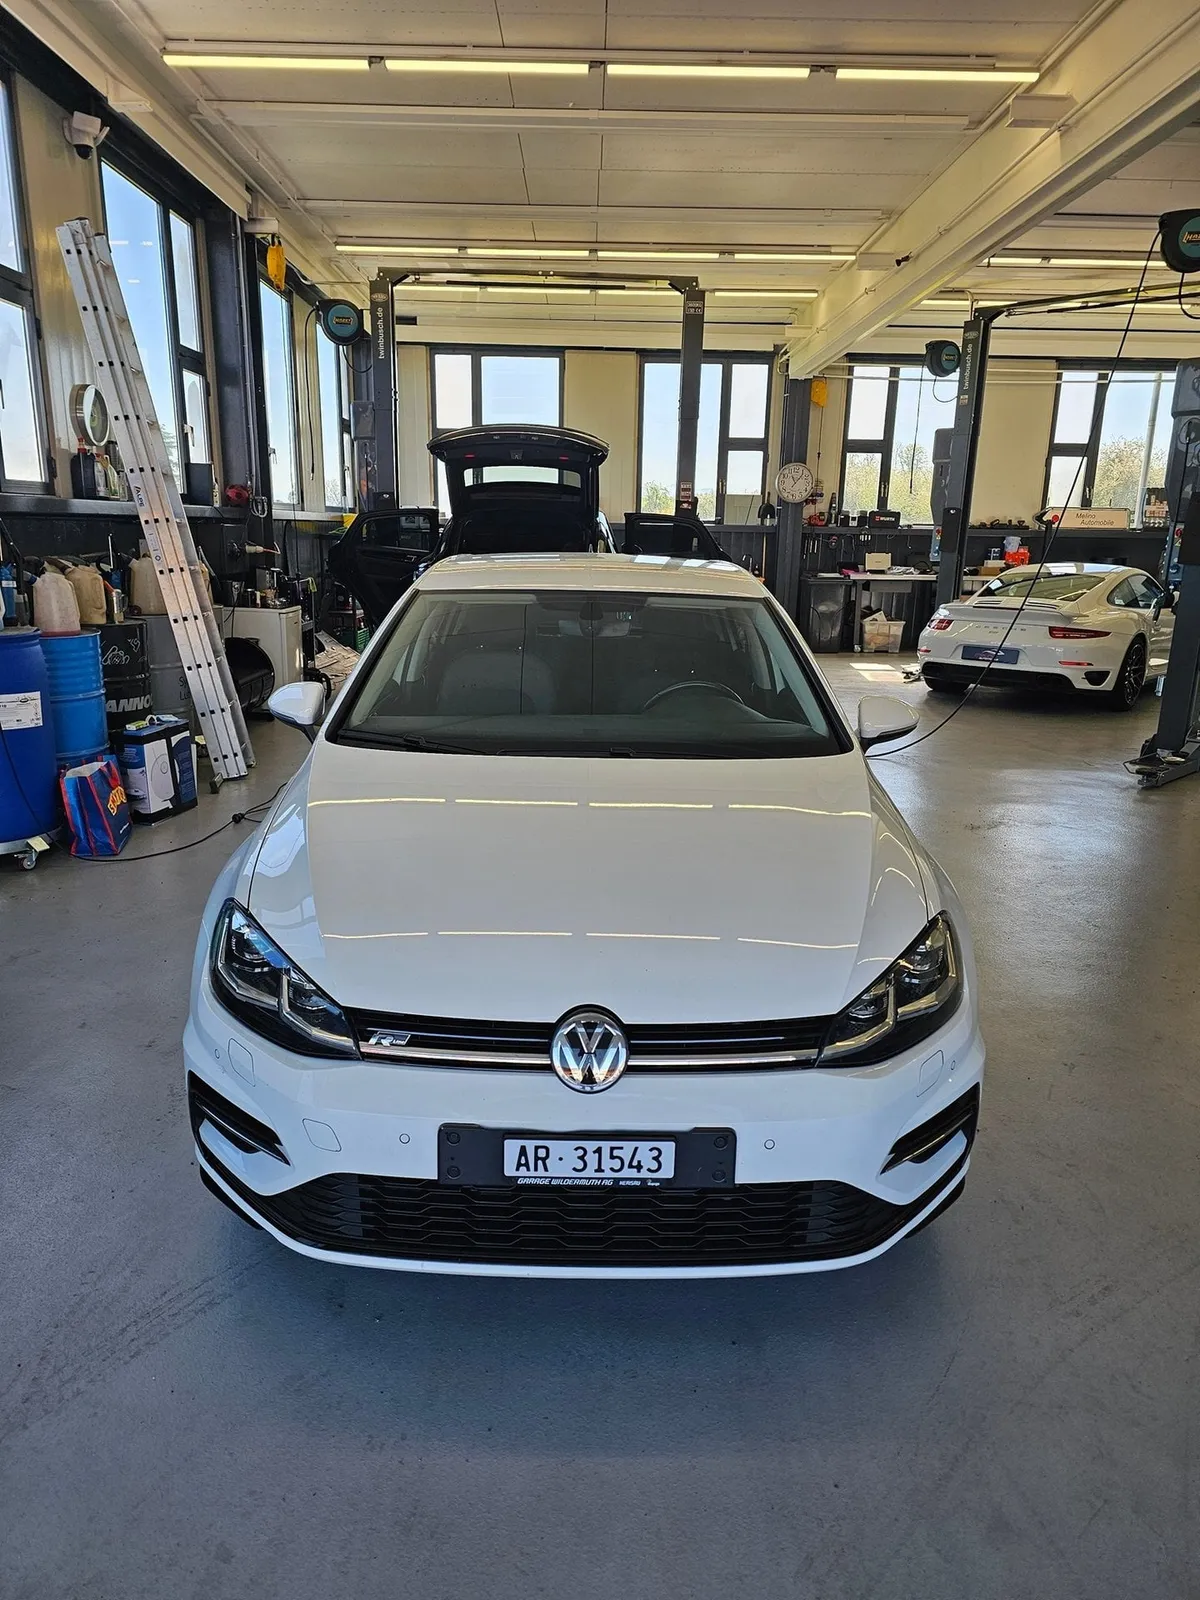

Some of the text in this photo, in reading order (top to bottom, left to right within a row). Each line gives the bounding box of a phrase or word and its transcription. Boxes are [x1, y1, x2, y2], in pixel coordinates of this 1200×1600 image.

[376, 307, 385, 359] twinbusch.de
[106, 694, 152, 713] ANNO
[515, 1145, 663, 1174] AR 31543
[517, 1177, 550, 1185] GARAGE
[551, 1178, 601, 1186] WILDERMUTH
